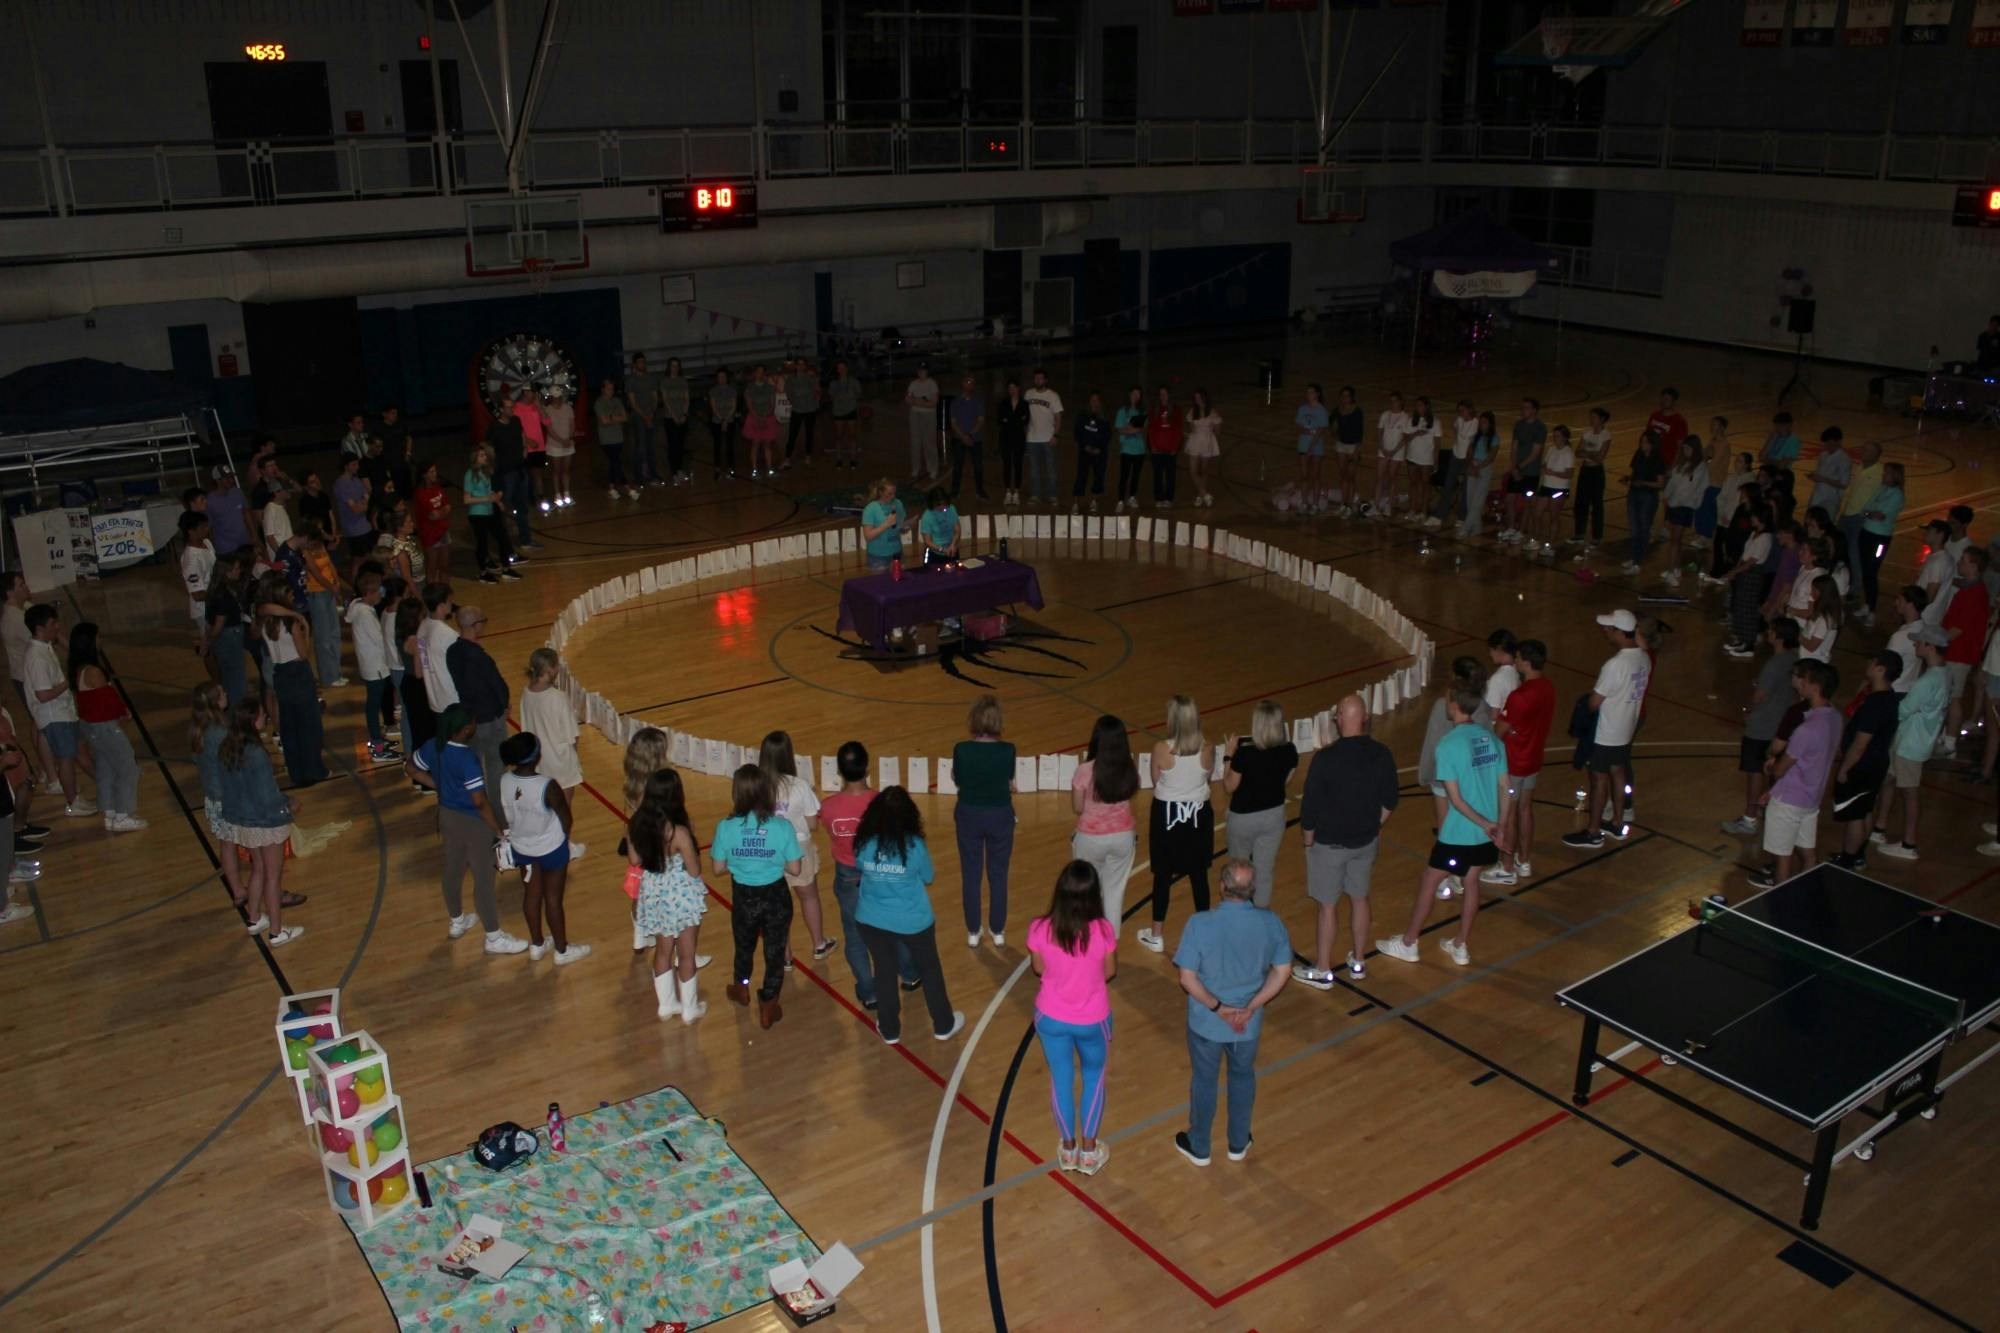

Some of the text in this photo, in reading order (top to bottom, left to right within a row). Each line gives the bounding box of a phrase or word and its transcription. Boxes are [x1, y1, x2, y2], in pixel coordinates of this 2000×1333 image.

[245, 44, 286, 61] 46:55
[697, 188, 732, 210] 8:10
[742, 838, 766, 848] EVENT
[731, 848, 776, 858] LEADERSHIP
